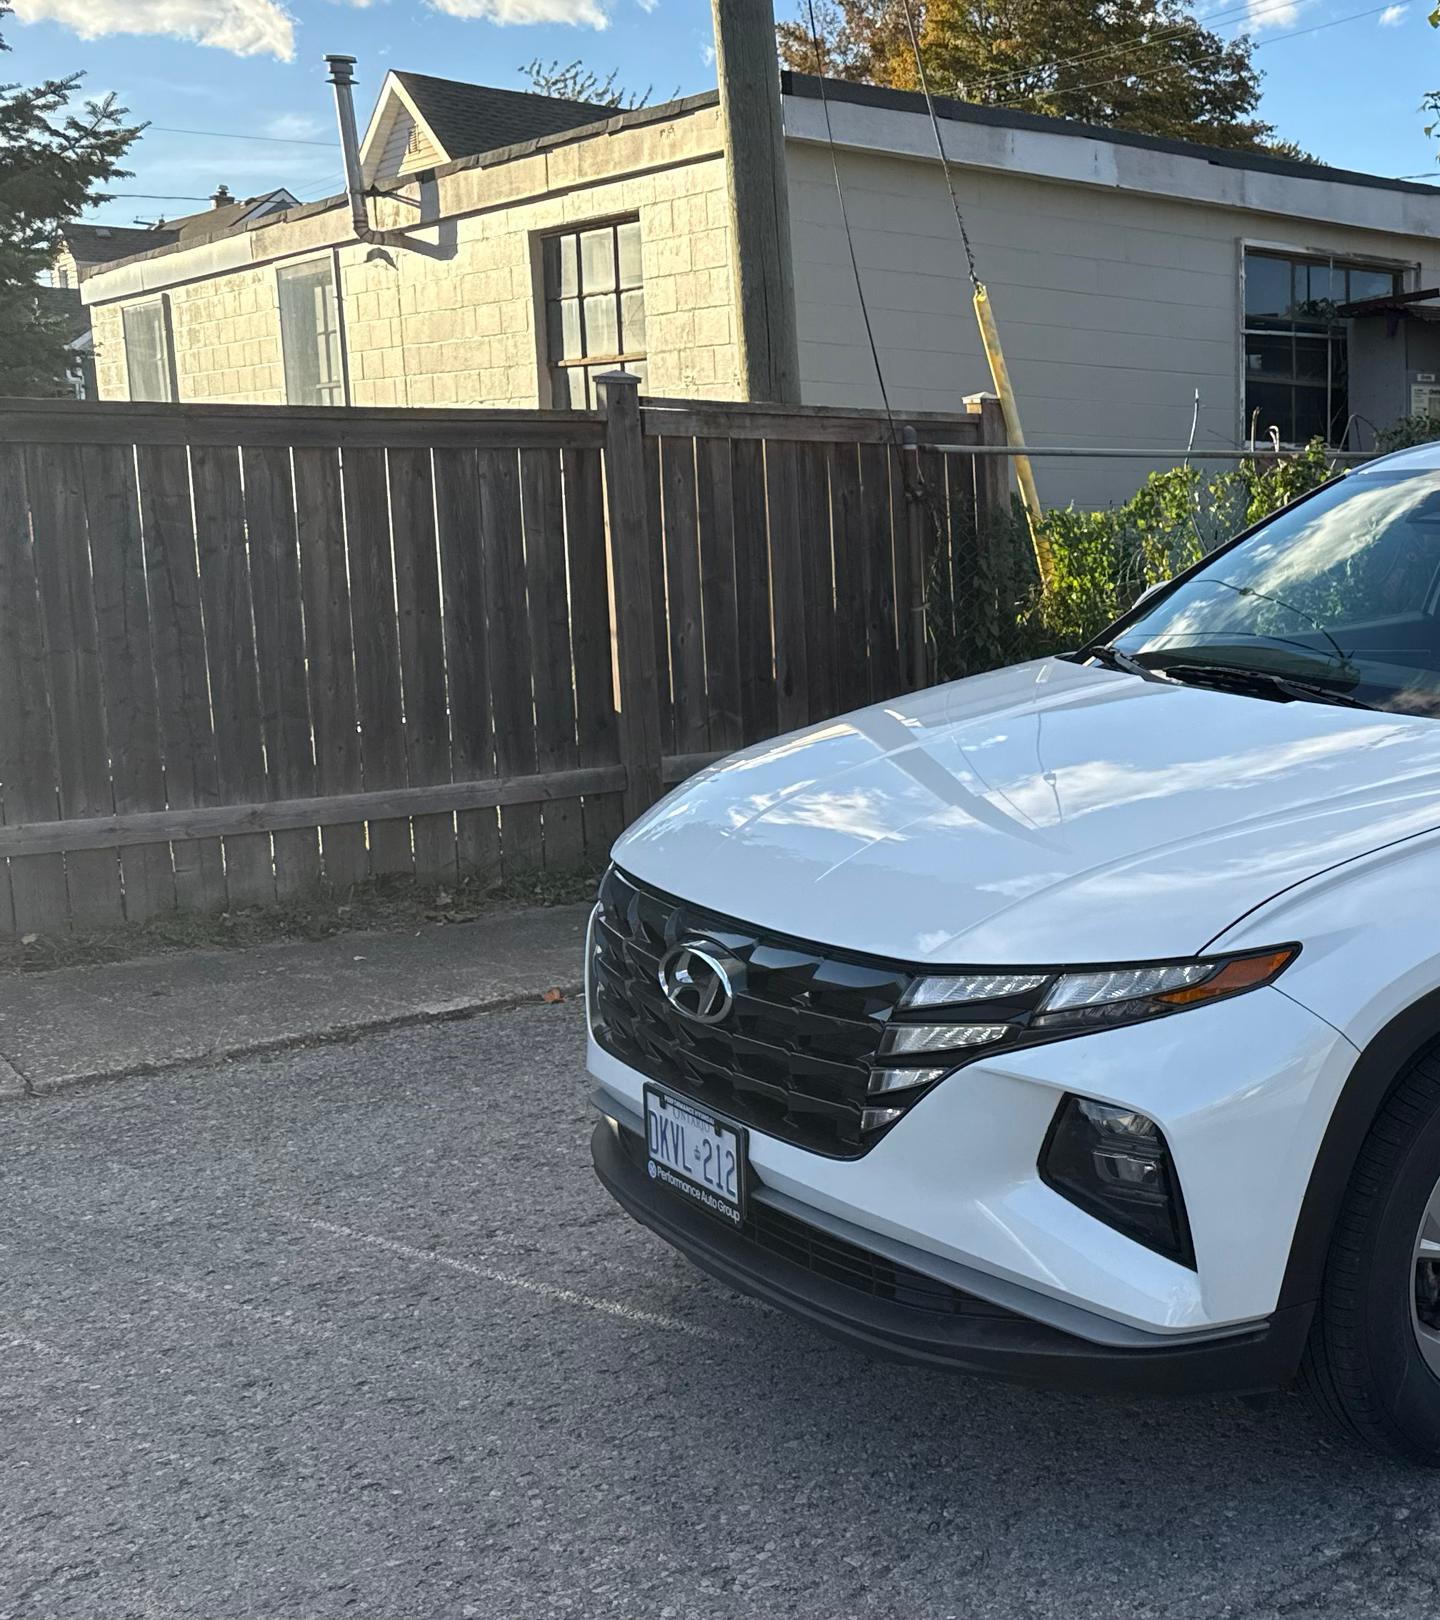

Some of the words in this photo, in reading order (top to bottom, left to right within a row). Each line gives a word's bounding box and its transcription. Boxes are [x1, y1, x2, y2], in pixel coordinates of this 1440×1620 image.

[672, 1107, 710, 1132] ONTARIO
[648, 1110, 692, 1173] DKVL
[703, 1138, 736, 1197] 212
[657, 1165, 700, 1200] Performance
[701, 1190, 717, 1208] Auto
[717, 1200, 740, 1224] Group
